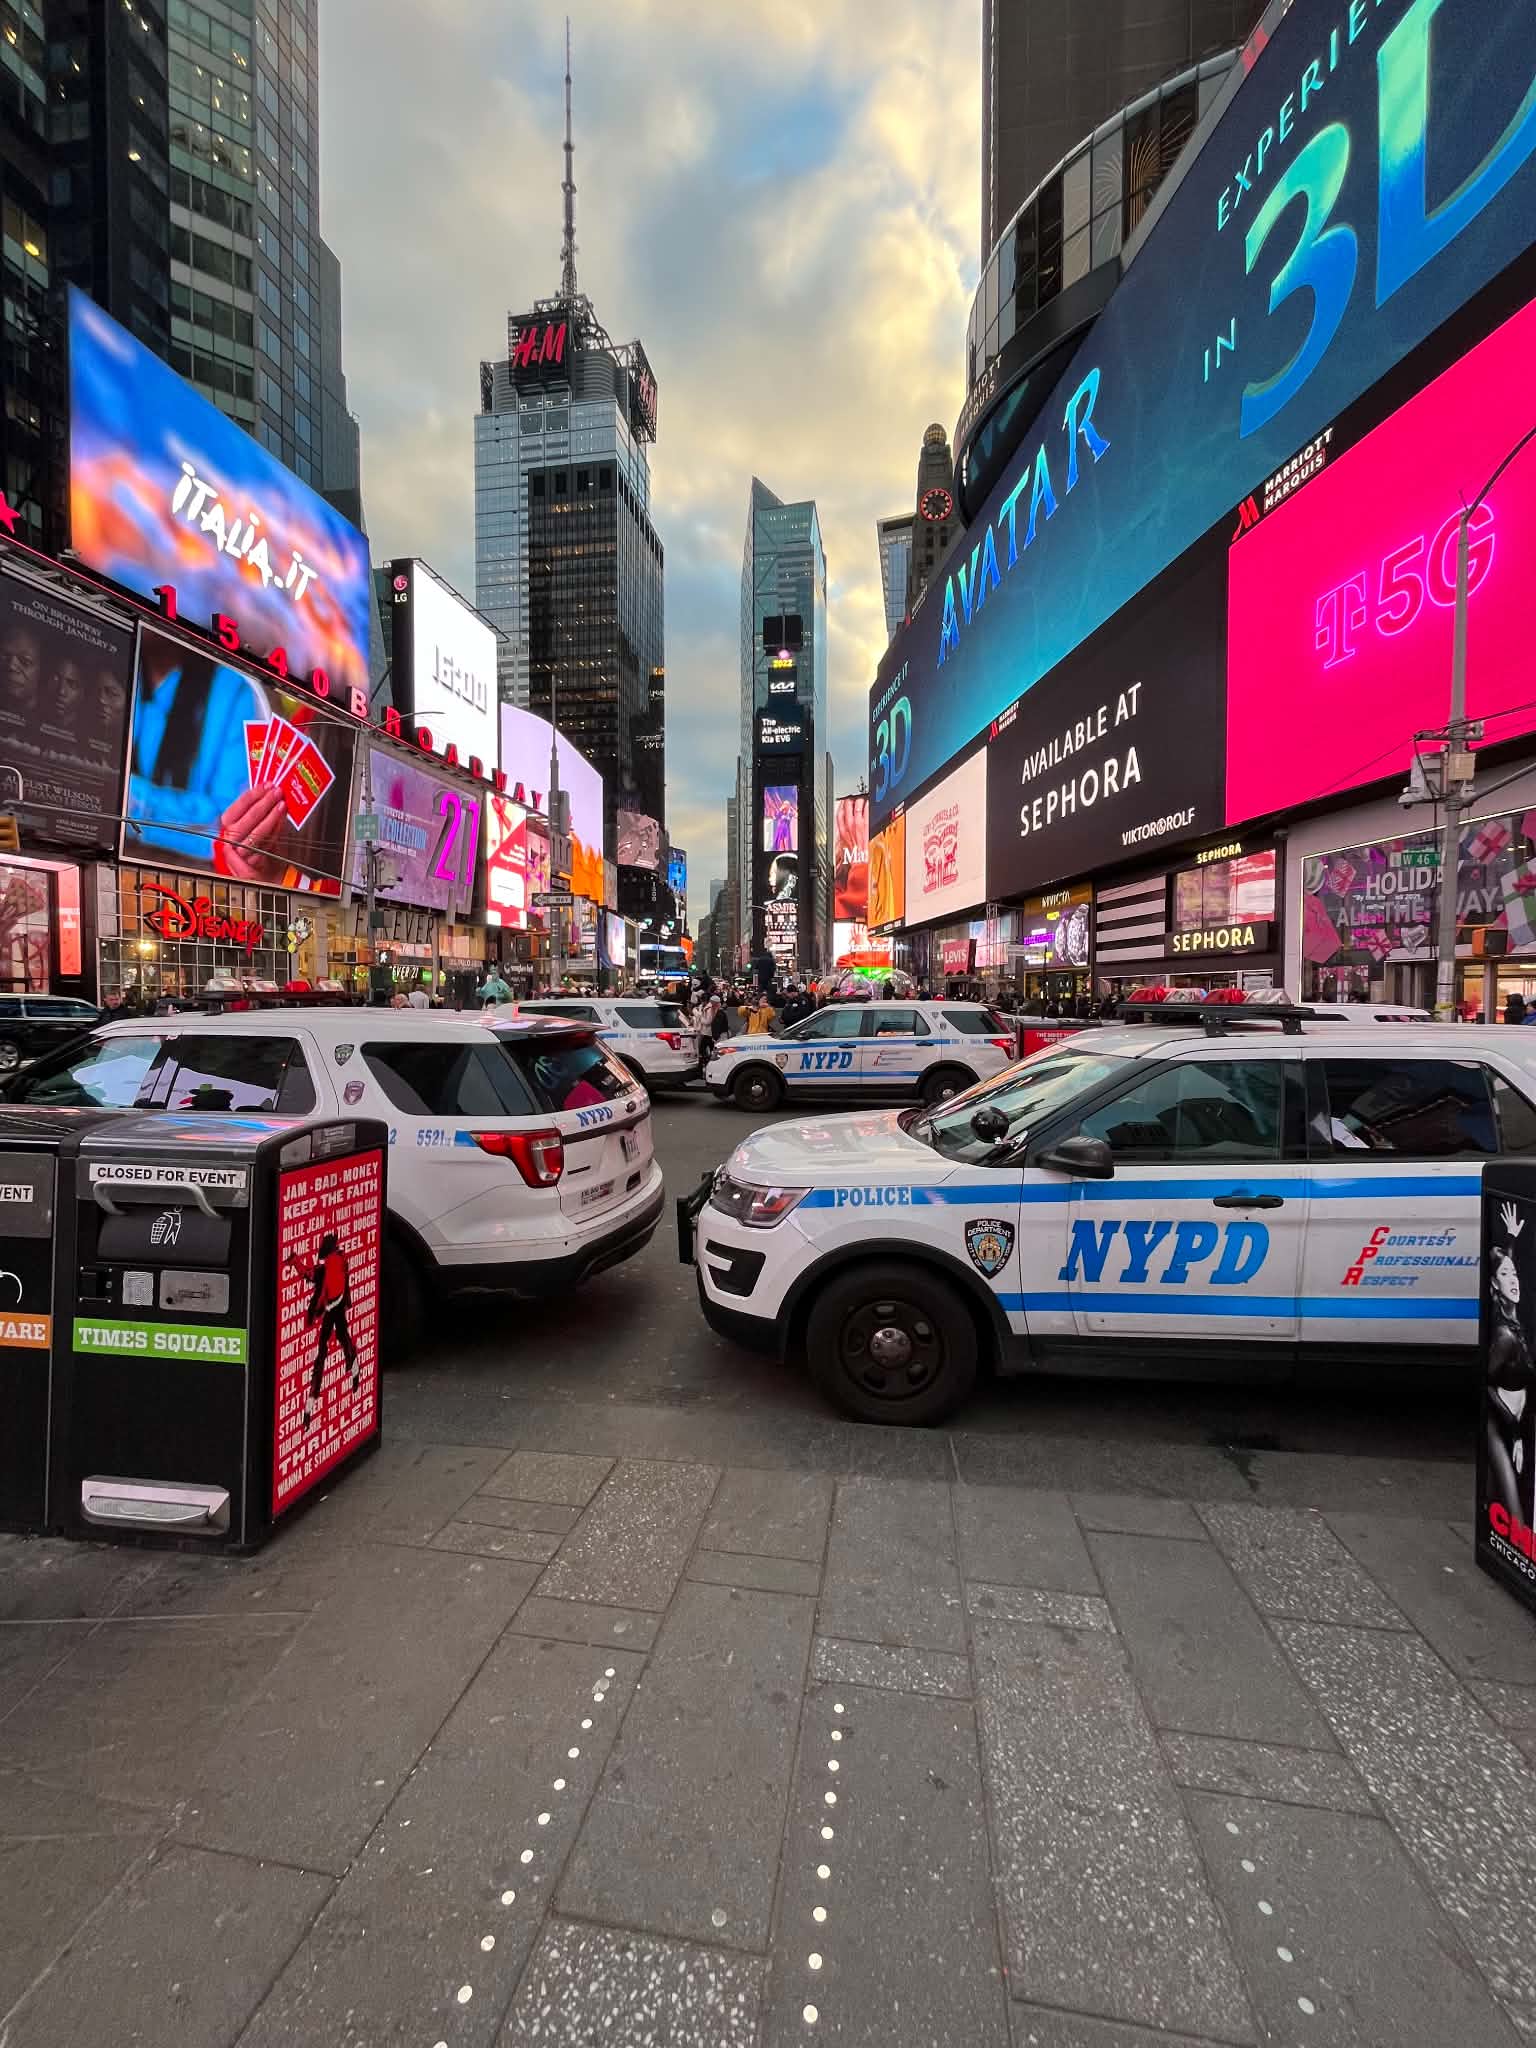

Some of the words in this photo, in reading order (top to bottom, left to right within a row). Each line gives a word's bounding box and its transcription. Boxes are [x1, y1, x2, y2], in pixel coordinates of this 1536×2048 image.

[1218, 0, 1384, 232] EXPERIE
[1204, 317, 1236, 383] IN
[1264, 427, 1334, 496] MARRIOTT
[1264, 453, 1326, 512] MARQUIS
[936, 367, 1111, 671] AVATAR
[1375, 503, 1496, 636] 5G
[394, 592, 408, 603] LG
[10, 600, 65, 631] THROUGH
[773, 659, 793, 668] 2022
[901, 660, 909, 681] IT
[155, 585, 331, 698] 1540
[349, 685, 544, 811] BROADWAY
[761, 718, 777, 726] The
[762, 726, 801, 736] All-electric
[1021, 705, 1108, 785] AVAILABLE
[1114, 681, 1142, 727] AT
[762, 735, 774, 744] Kia
[775, 735, 791, 743] EV6
[875, 695, 913, 803] 3D
[1020, 746, 1142, 837] SEPHORA
[427, 789, 480, 887] 21
[1196, 842, 1242, 864] SEPHORA
[1402, 853, 1413, 866] W
[1417, 853, 1431, 865] 46
[1366, 863, 1463, 898] HOLIDA
[354, 902, 434, 945] FEVER
[1172, 926, 1256, 953] SEPHORA
[800, 1051, 853, 1070] NYPD
[575, 1106, 614, 1128] NYPD
[97, 1167, 152, 1180] CLOSED
[156, 1170, 184, 1183] FOR
[189, 1172, 237, 1186] EVENT
[283, 1181, 307, 1202] JAM
[314, 1173, 338, 1193] BAD
[343, 1161, 378, 1183] MONEY
[283, 1197, 318, 1221] KEEP
[320, 1188, 344, 1208] THE
[346, 1178, 378, 1200] FAITH
[836, 1186, 910, 1208] POLICE
[306, 1214, 326, 1234] JEAN
[312, 1233, 321, 1250] IT
[337, 1222, 351, 1239] THE
[367, 1229, 377, 1244] IT
[967, 1226, 1012, 1238] DEPARTMENT
[977, 1220, 1002, 1228] POLICE
[1057, 1219, 1270, 1285] NYPD
[1354, 1246, 1480, 1267] PROFESSIONALI
[281, 1280, 302, 1304] THEY
[347, 1250, 367, 1271] BOUT
[367, 1246, 377, 1262] US
[1340, 1266, 1419, 1286] RESPECT
[281, 1292, 314, 1323] DANC
[348, 1262, 377, 1288] CHINE
[281, 1316, 305, 1341] MAN
[350, 1279, 376, 1305] IRROR
[78, 1327, 148, 1350] TIMES
[154, 1332, 242, 1357] SQUARE
[300, 1328, 318, 1350] STOP
[279, 1378, 306, 1402] I'LL
[302, 1365, 315, 1387] BE
[357, 1343, 375, 1366] TURE
[328, 1386, 337, 1404] IN
[341, 1361, 375, 1395] MOCOW
[280, 1393, 301, 1420] BEAT
[328, 1403, 338, 1421] THE
[279, 1395, 374, 1476] THRILLER
[277, 1466, 303, 1499] WANNA
[304, 1458, 313, 1477] BE
[1489, 1536, 1536, 1580] CHICAGO
